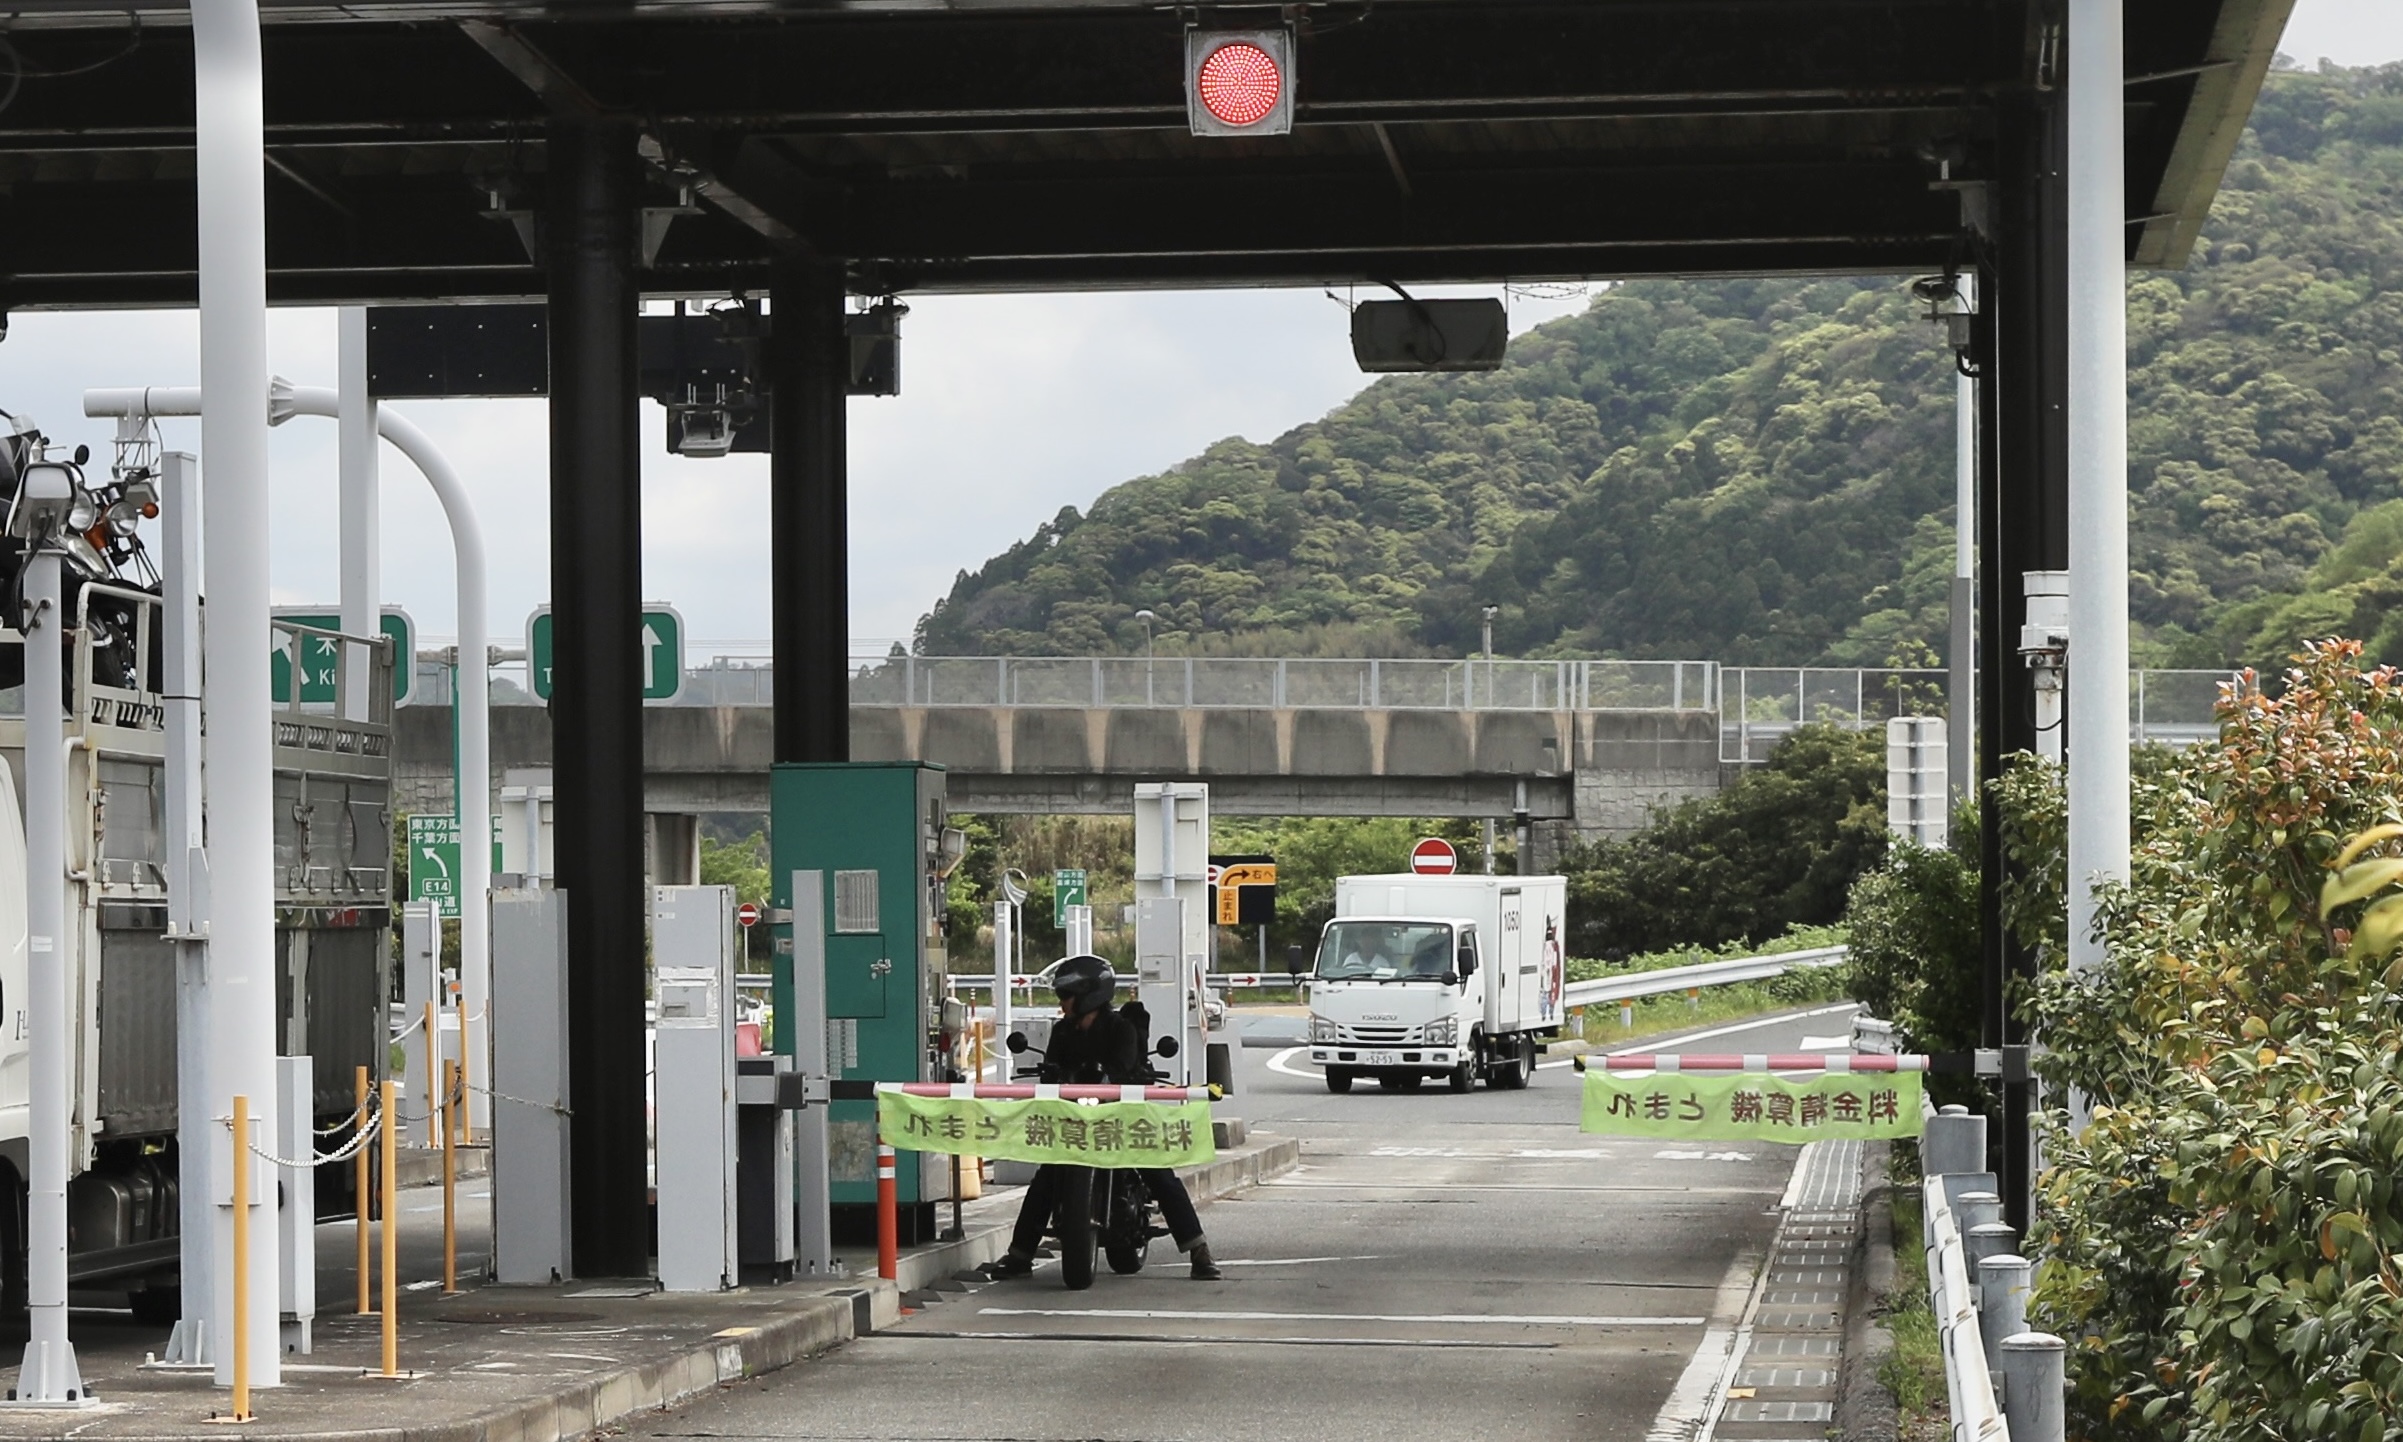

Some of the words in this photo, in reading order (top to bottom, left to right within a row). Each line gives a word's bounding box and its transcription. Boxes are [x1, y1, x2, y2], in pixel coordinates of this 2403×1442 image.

[411, 818, 460, 831] 東京方面
[411, 831, 460, 845] 千葉方面
[1252, 869, 1274, 880] 右へ
[425, 881, 449, 892] E14
[1222, 890, 1233, 922] 止まれ
[1504, 910, 1520, 932] 1050
[1361, 1013, 1398, 1021] ISUZU
